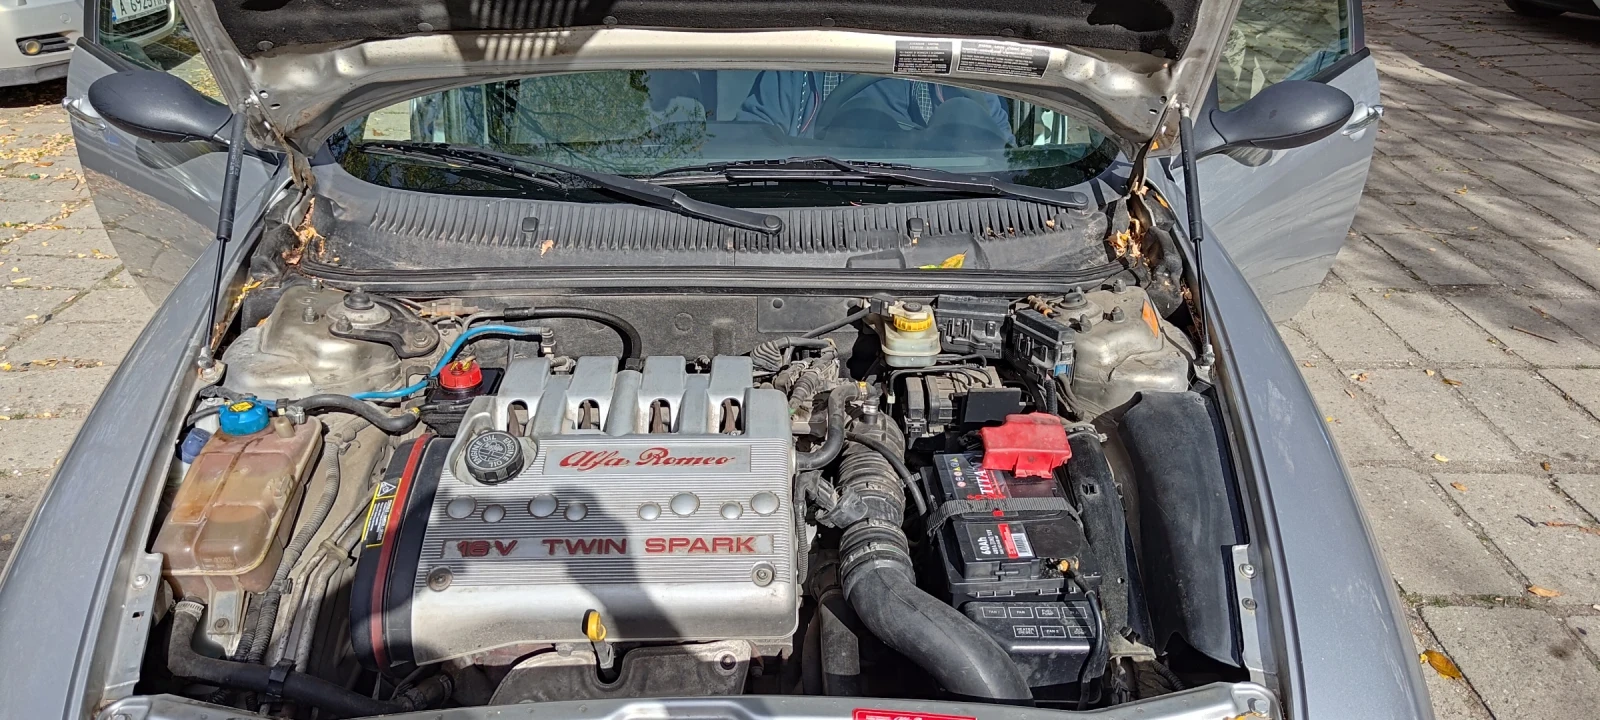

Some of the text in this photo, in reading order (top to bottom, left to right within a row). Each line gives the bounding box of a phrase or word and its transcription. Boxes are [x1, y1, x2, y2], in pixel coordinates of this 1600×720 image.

[471, 434, 497, 465] ENGINE OIL
[503, 437, 515, 461] ENGINE
[559, 447, 736, 472] Alfa Romeo
[542, 538, 627, 555] TWIN
[645, 536, 755, 553] SPARK
[977, 536, 992, 555] 60Ah
